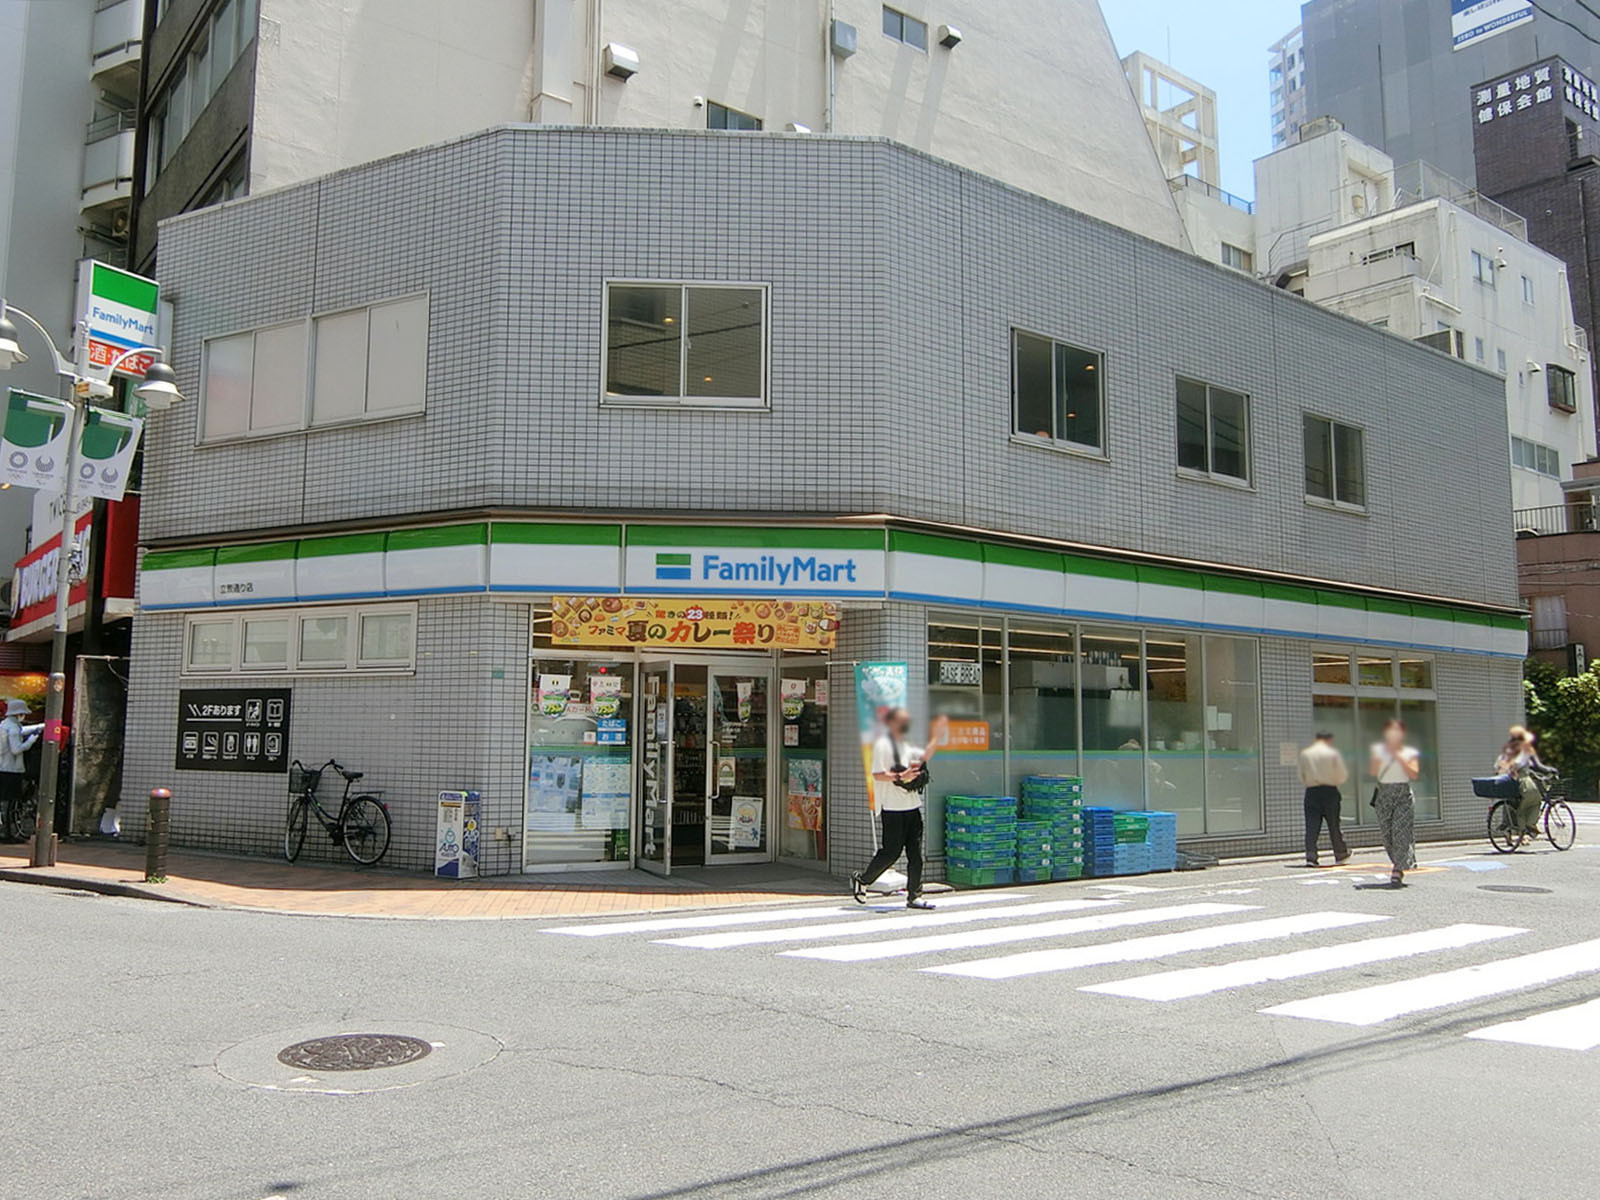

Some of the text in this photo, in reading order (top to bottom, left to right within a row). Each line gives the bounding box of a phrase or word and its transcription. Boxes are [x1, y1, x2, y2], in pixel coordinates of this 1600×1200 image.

[1476, 66, 1552, 106] 測量地質
[1478, 85, 1553, 124] 健保会館
[92, 306, 154, 335] FamilyMart
[702, 555, 857, 586] FamilyMart
[202, 705, 242, 716] 2Fあります
[643, 676, 661, 856] FamilyMart
